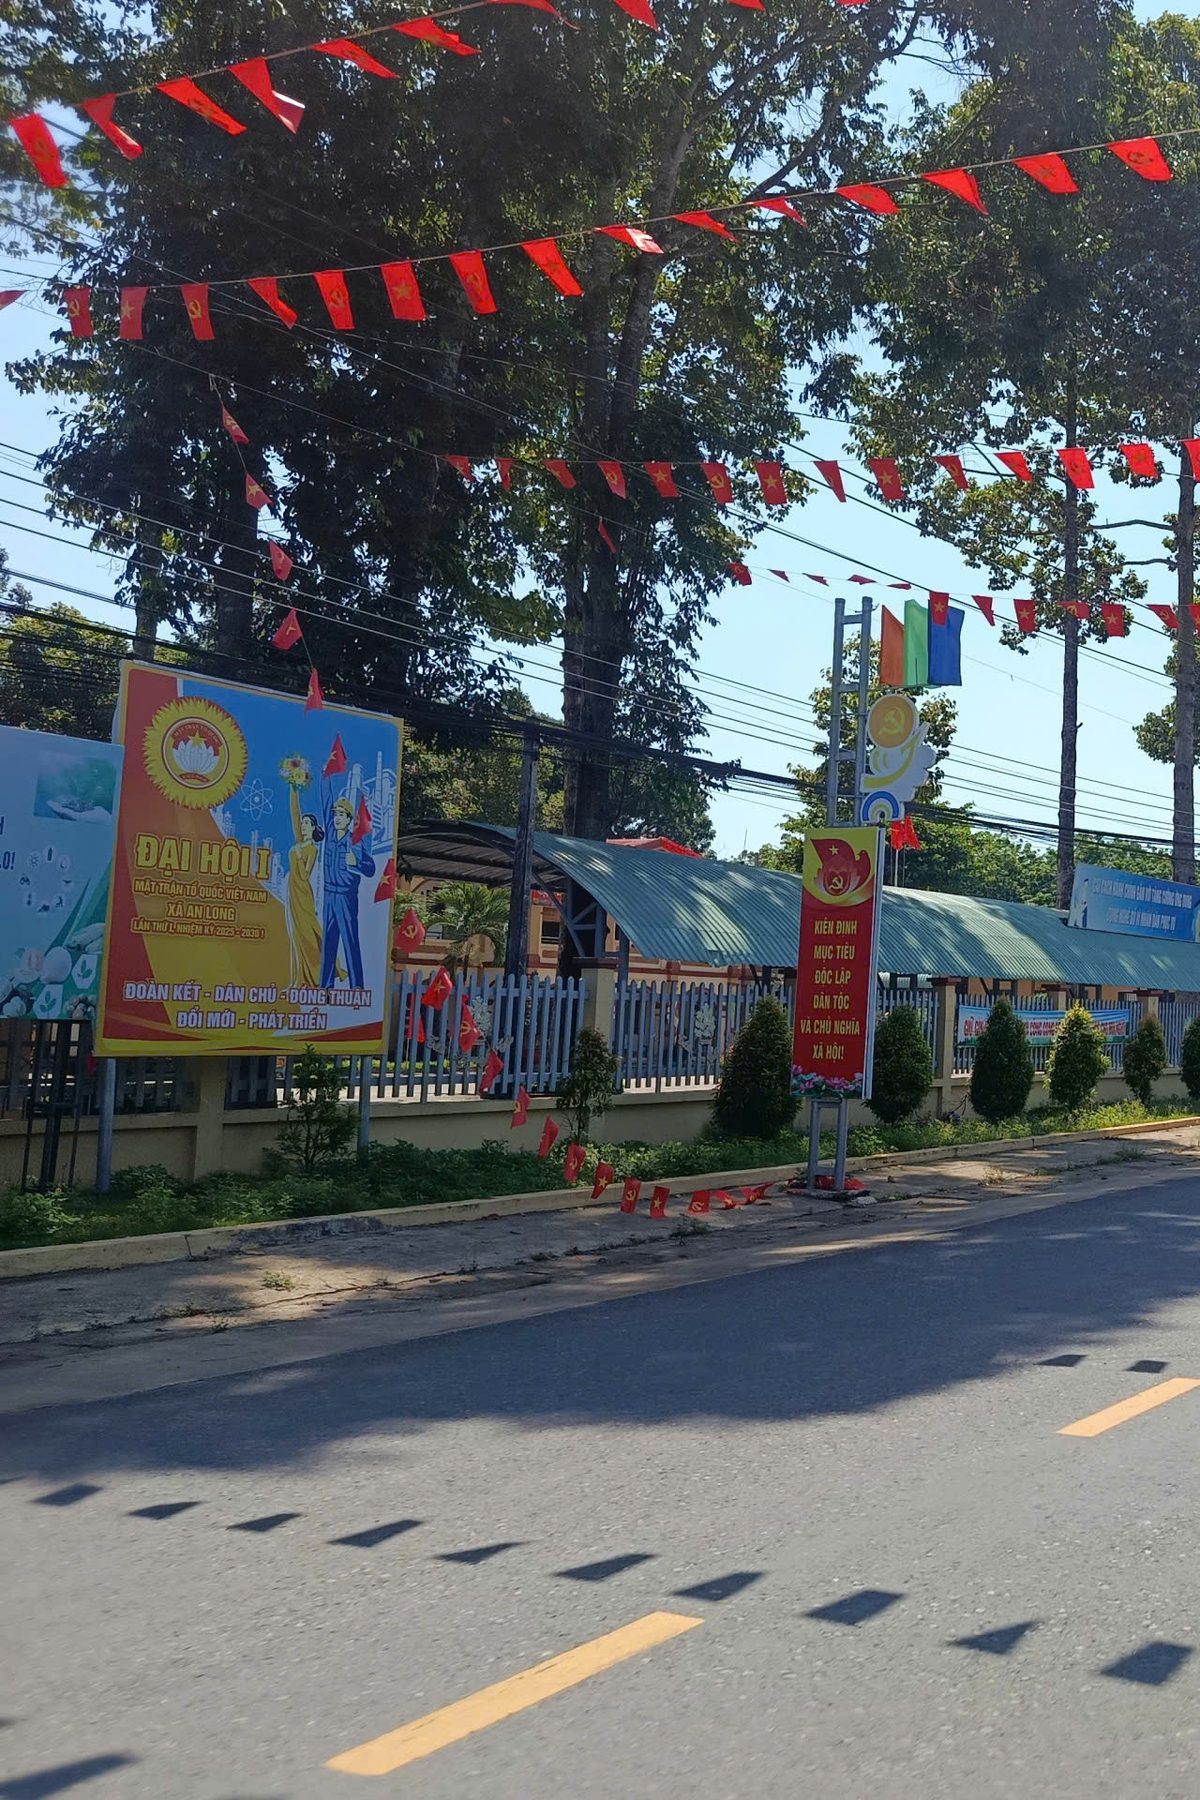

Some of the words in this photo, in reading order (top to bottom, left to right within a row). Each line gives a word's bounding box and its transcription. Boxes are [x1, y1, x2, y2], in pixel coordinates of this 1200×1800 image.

[136, 834, 191, 877] ĐẠI
[201, 839, 250, 882] HỘI
[257, 849, 270, 879] I
[134, 879, 155, 896] MẶT
[159, 881, 183, 897] TRẬN
[199, 883, 224, 898] QUỐC
[225, 887, 244, 902] VIỆT
[246, 890, 267, 902] NAM
[167, 900, 184, 918] XÃ
[186, 904, 203, 918] AN
[205, 906, 235, 921] LONG
[176, 922, 203, 937] NHIỆM
[204, 922, 215, 936] KỲ
[215, 926, 235, 937] 2025
[241, 928, 259, 939] 2030
[814, 917, 834, 935] KIÊN
[836, 920, 857, 938] ĐỊNH
[814, 945, 833, 963] MỤC
[836, 942, 855, 960] TIÊU
[815, 967, 832, 987] ĐỘC
[835, 967, 851, 987] LẬP
[125, 979, 169, 1001] ĐOÀN
[173, 979, 202, 1001] KẾT
[214, 984, 245, 1002] DÂN
[248, 983, 277, 1003] CHỦ
[289, 984, 326, 1005] ĐỒNG
[329, 988, 371, 1009] THUẬN
[813, 992, 830, 1009] DÂN
[833, 992, 850, 1012] TỘC
[177, 1005, 203, 1028] ĐỔI
[207, 1008, 236, 1028] MỚI
[248, 1010, 286, 1029] PHÁT
[288, 1007, 328, 1030] TRIỂN
[800, 1016, 811, 1034] VÀ
[813, 1015, 831, 1034] CHỦ
[833, 1017, 860, 1036] NGHĨA
[812, 1041, 824, 1059] XÃ
[826, 1041, 844, 1063] HỘI!
